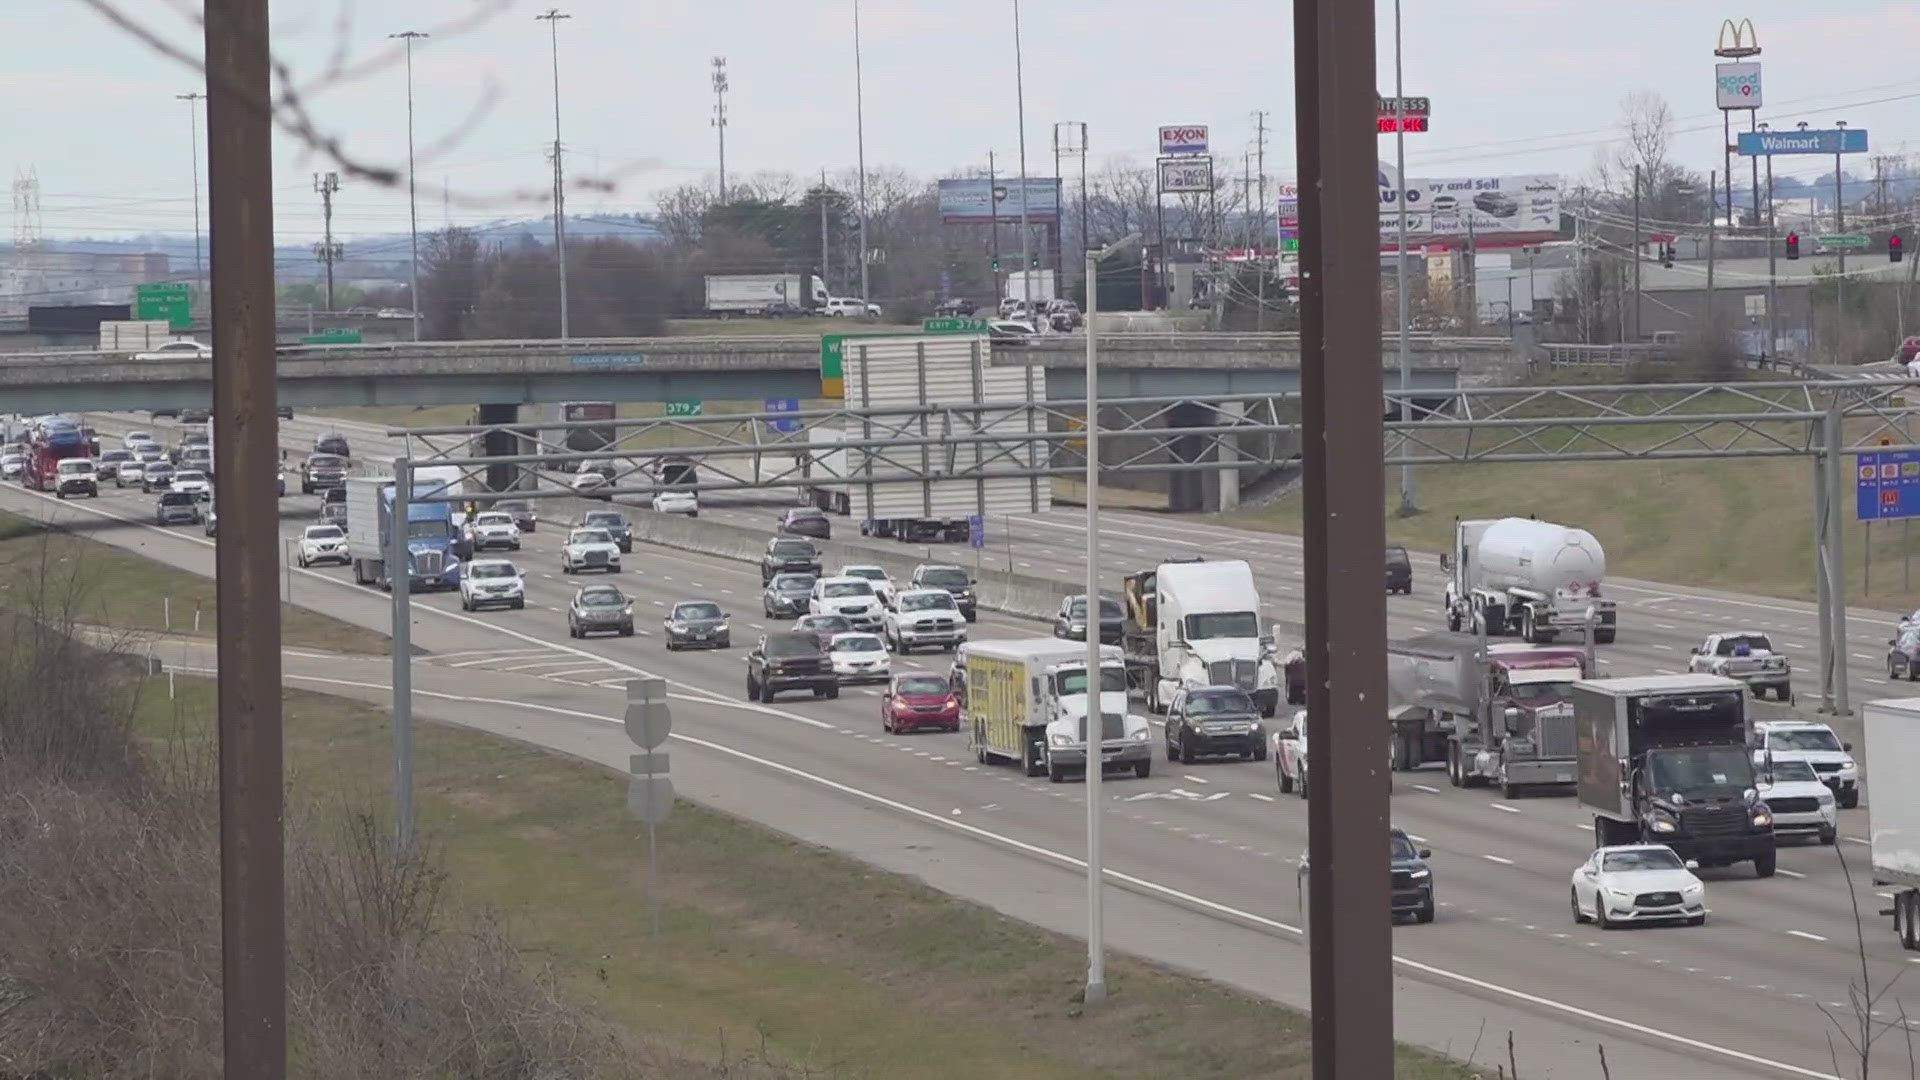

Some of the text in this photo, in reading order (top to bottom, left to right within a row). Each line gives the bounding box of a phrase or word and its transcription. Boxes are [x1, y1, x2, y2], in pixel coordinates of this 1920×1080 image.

[1718, 72, 1758, 89] good
[1163, 128, 1205, 143] EXXON
[1760, 134, 1820, 150] Walmart
[1183, 169, 1206, 177] TACO
[1447, 179, 1472, 190] and
[1475, 178, 1499, 190] Sell
[1434, 220, 1458, 230] Used
[930, 319, 981, 329] EXIT 379
[668, 402, 690, 414] 379
